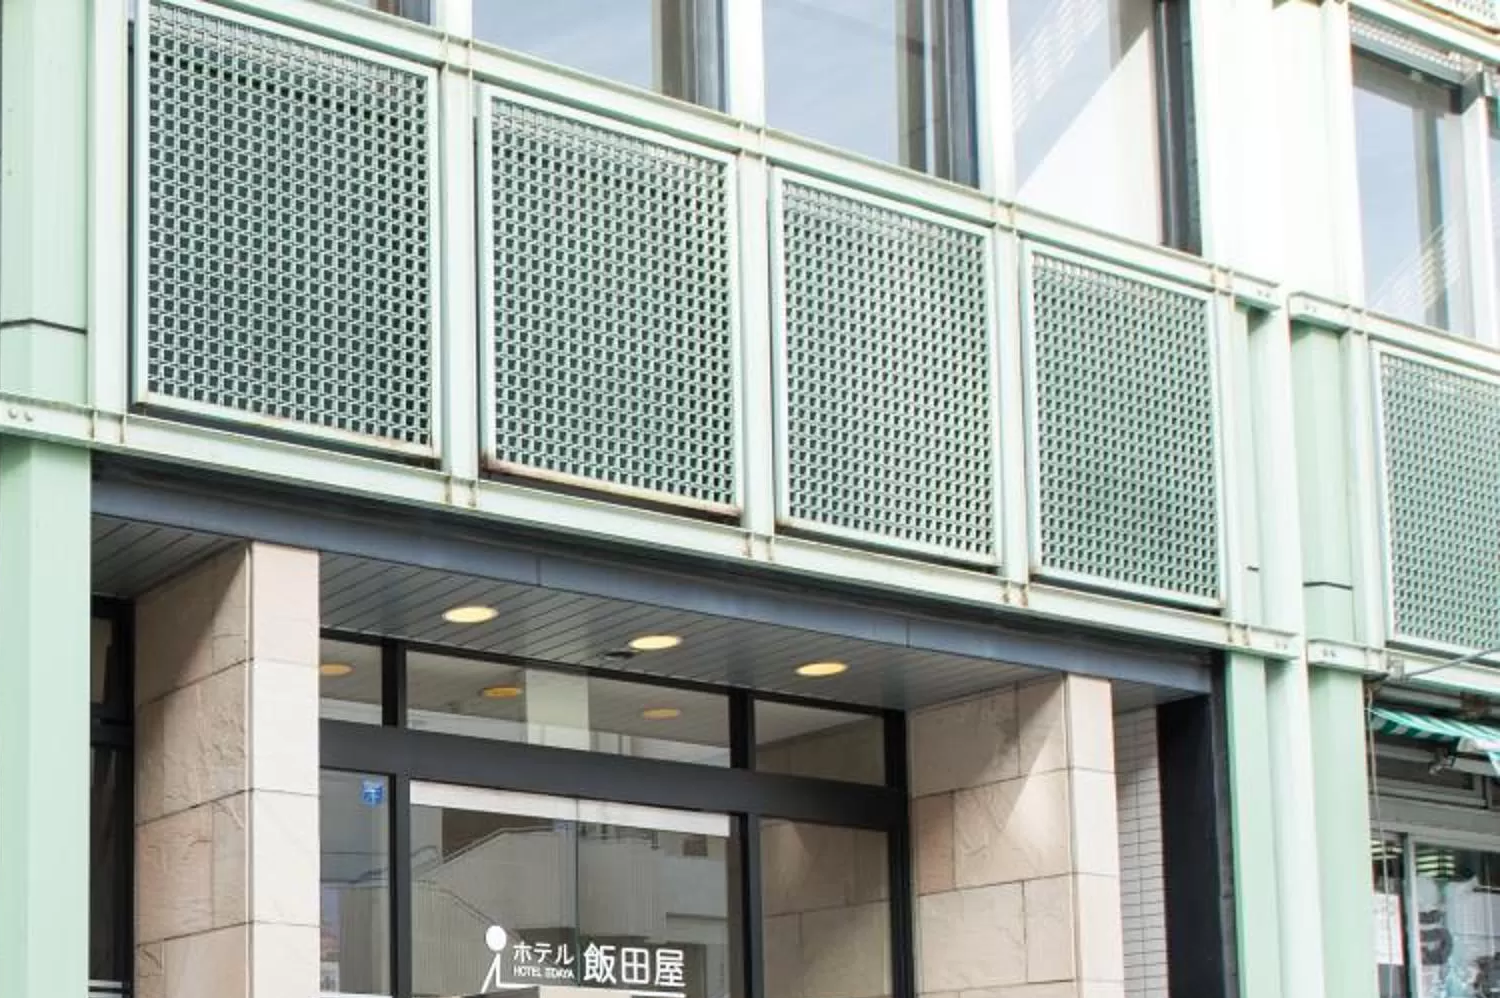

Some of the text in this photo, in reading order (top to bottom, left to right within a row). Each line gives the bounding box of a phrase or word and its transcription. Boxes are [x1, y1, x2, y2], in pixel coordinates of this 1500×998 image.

[513, 941, 687, 988] ホテル 飯田屋
[513, 965, 542, 978] HOTEL
